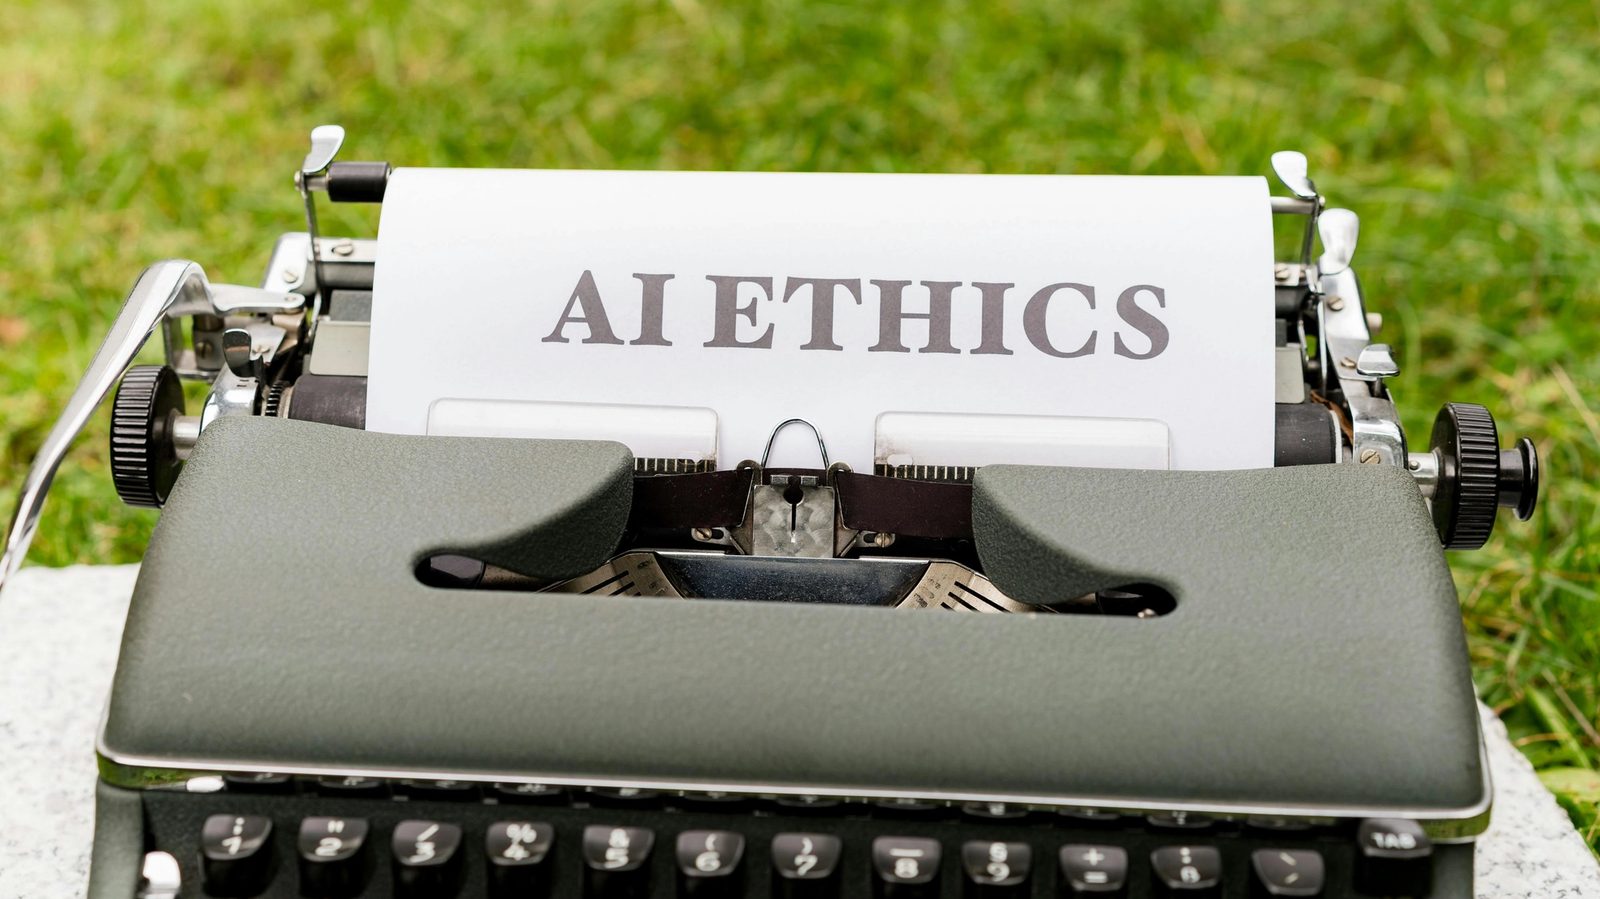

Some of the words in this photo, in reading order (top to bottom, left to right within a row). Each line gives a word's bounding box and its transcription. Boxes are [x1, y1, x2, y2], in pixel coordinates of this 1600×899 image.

[541, 269, 676, 348] AI
[702, 274, 1171, 360] ETHICS
[221, 836, 242, 856] 1
[314, 837, 343, 857] 2
[1370, 831, 1418, 850] TAB
[408, 841, 435, 863] 3
[604, 847, 629, 869] 5
[695, 851, 721, 872] 6
[793, 854, 819, 877] 7
[894, 857, 919, 879] 8
[986, 862, 1011, 882] 9
